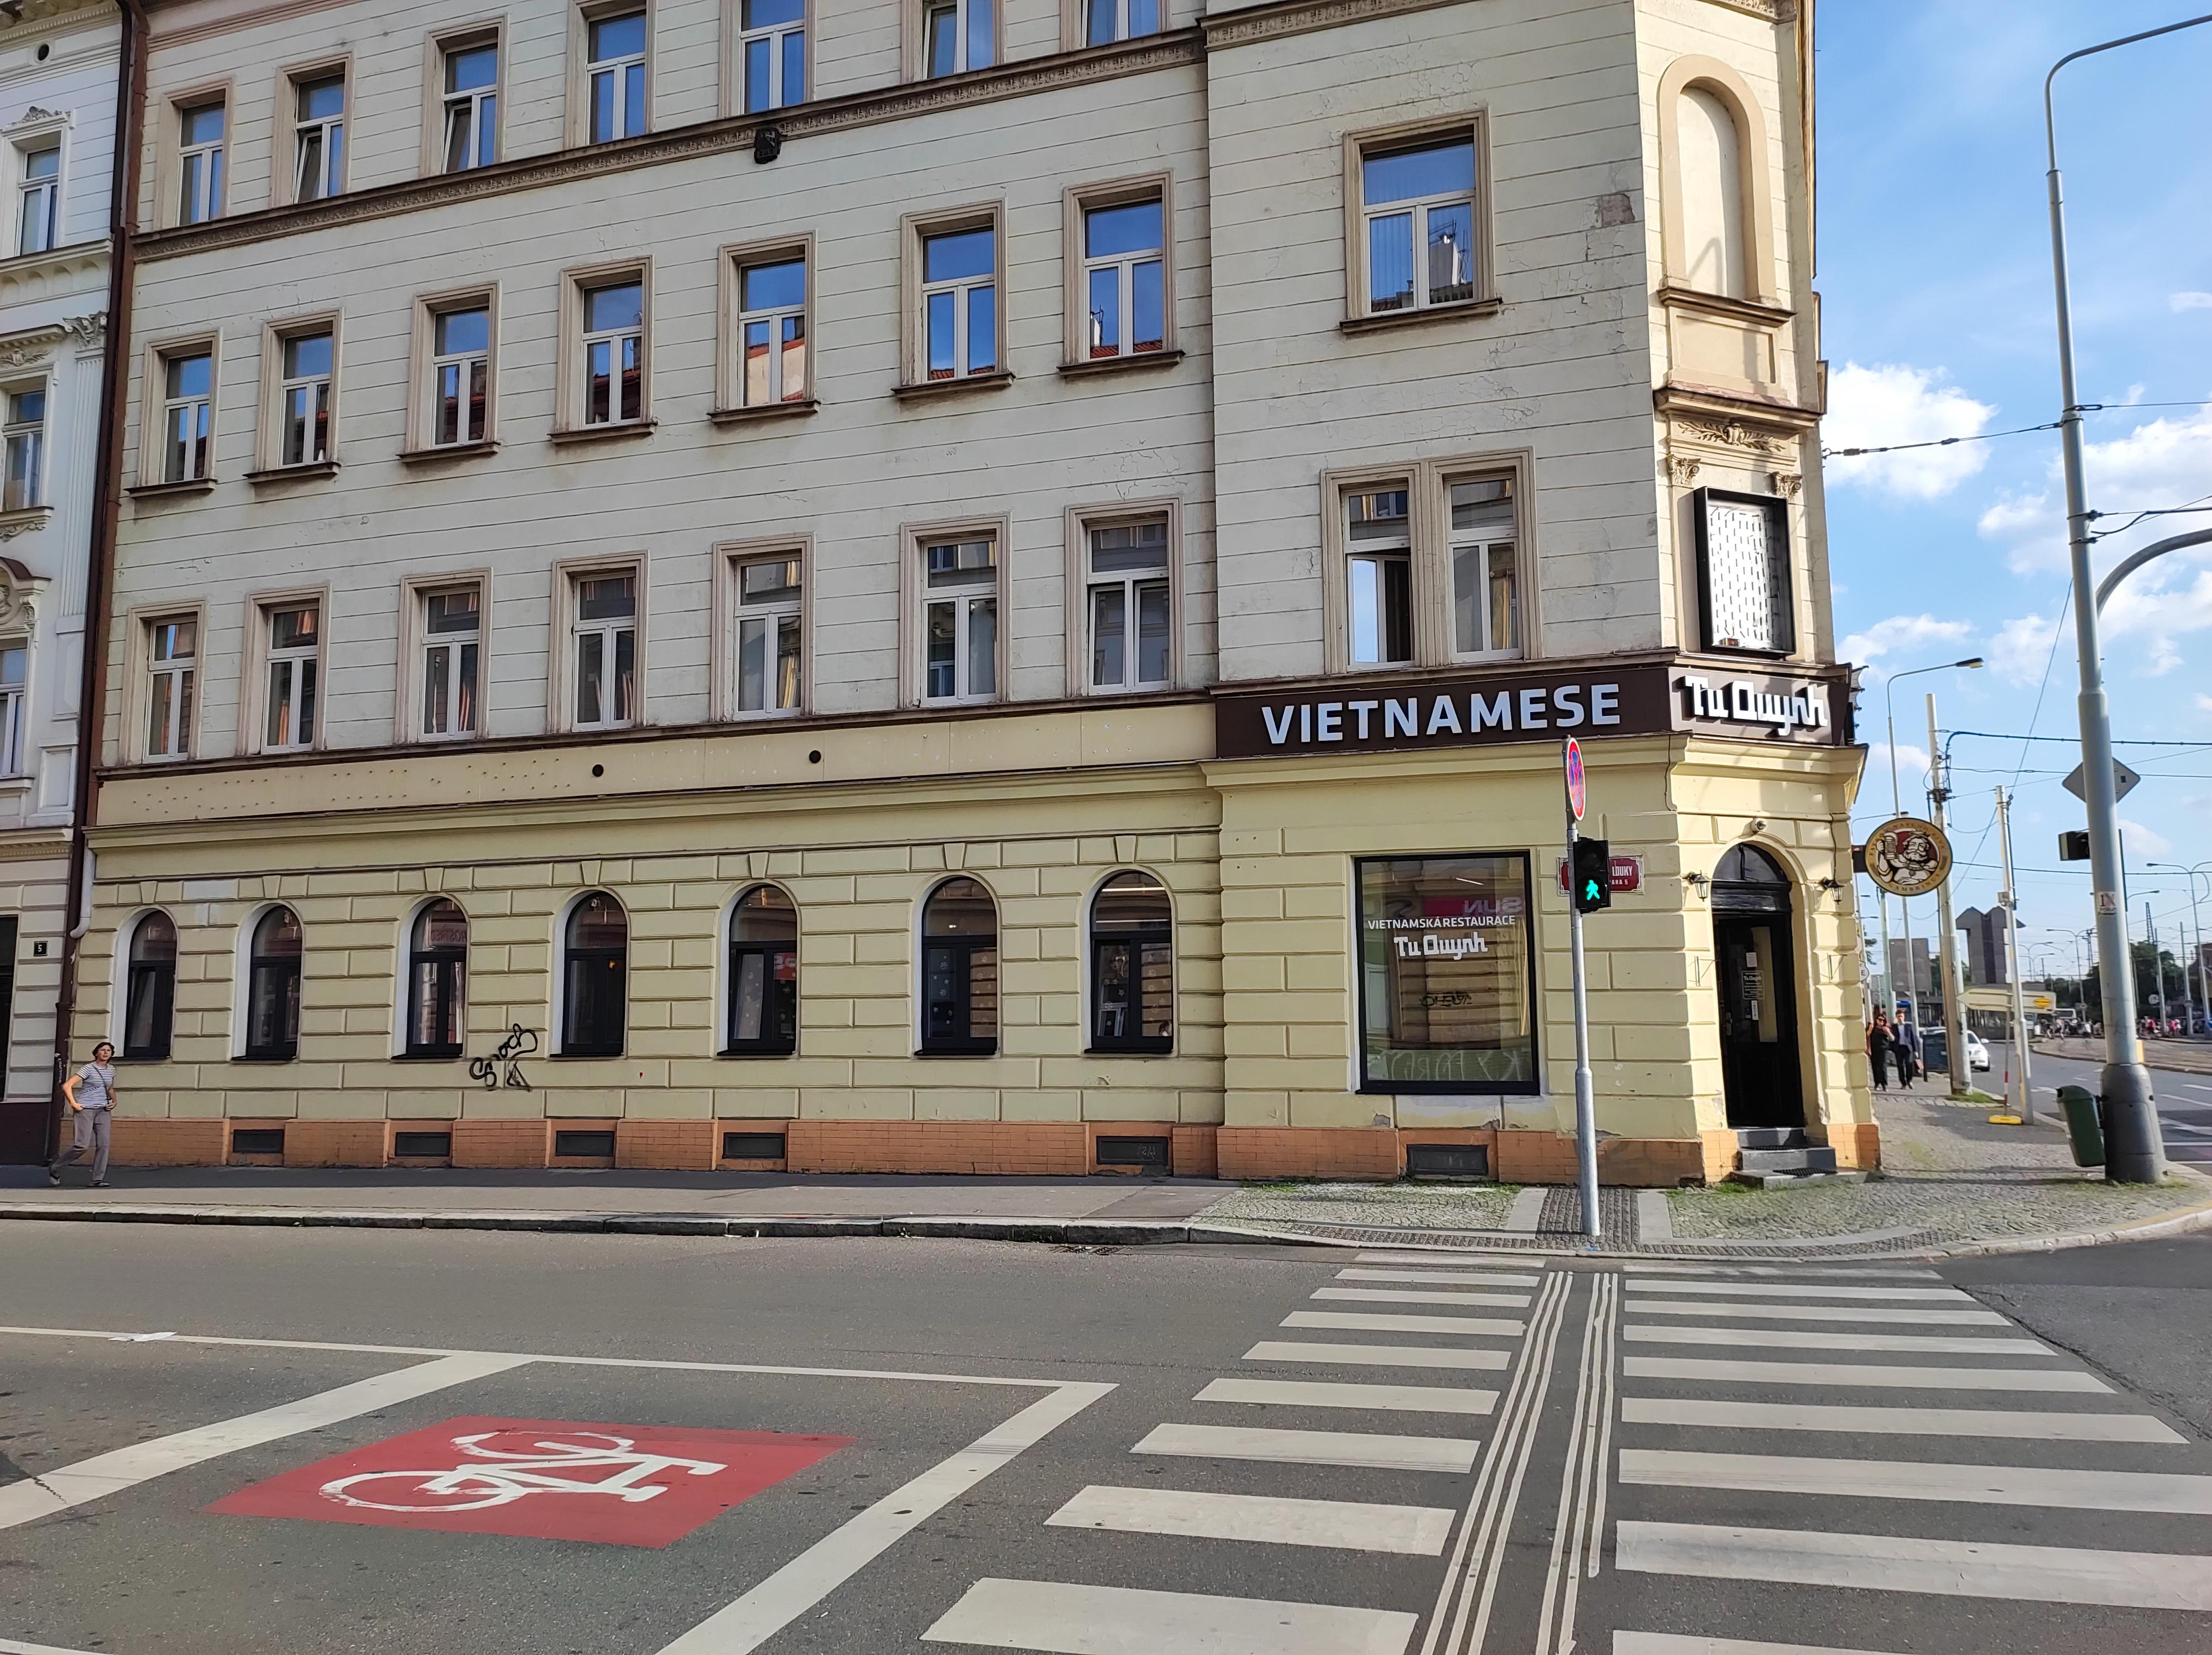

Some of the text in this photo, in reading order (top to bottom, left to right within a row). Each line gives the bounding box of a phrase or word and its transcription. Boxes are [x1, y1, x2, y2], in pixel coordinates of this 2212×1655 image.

[1685, 675, 1729, 718] Tu
[1261, 683, 1621, 744] VIETNAMESE
[1612, 866, 1632, 876] LOUKY
[1368, 915, 1516, 930] VIETNAMSKÁ RESTAURACE
[1394, 936, 1421, 957] Tu
